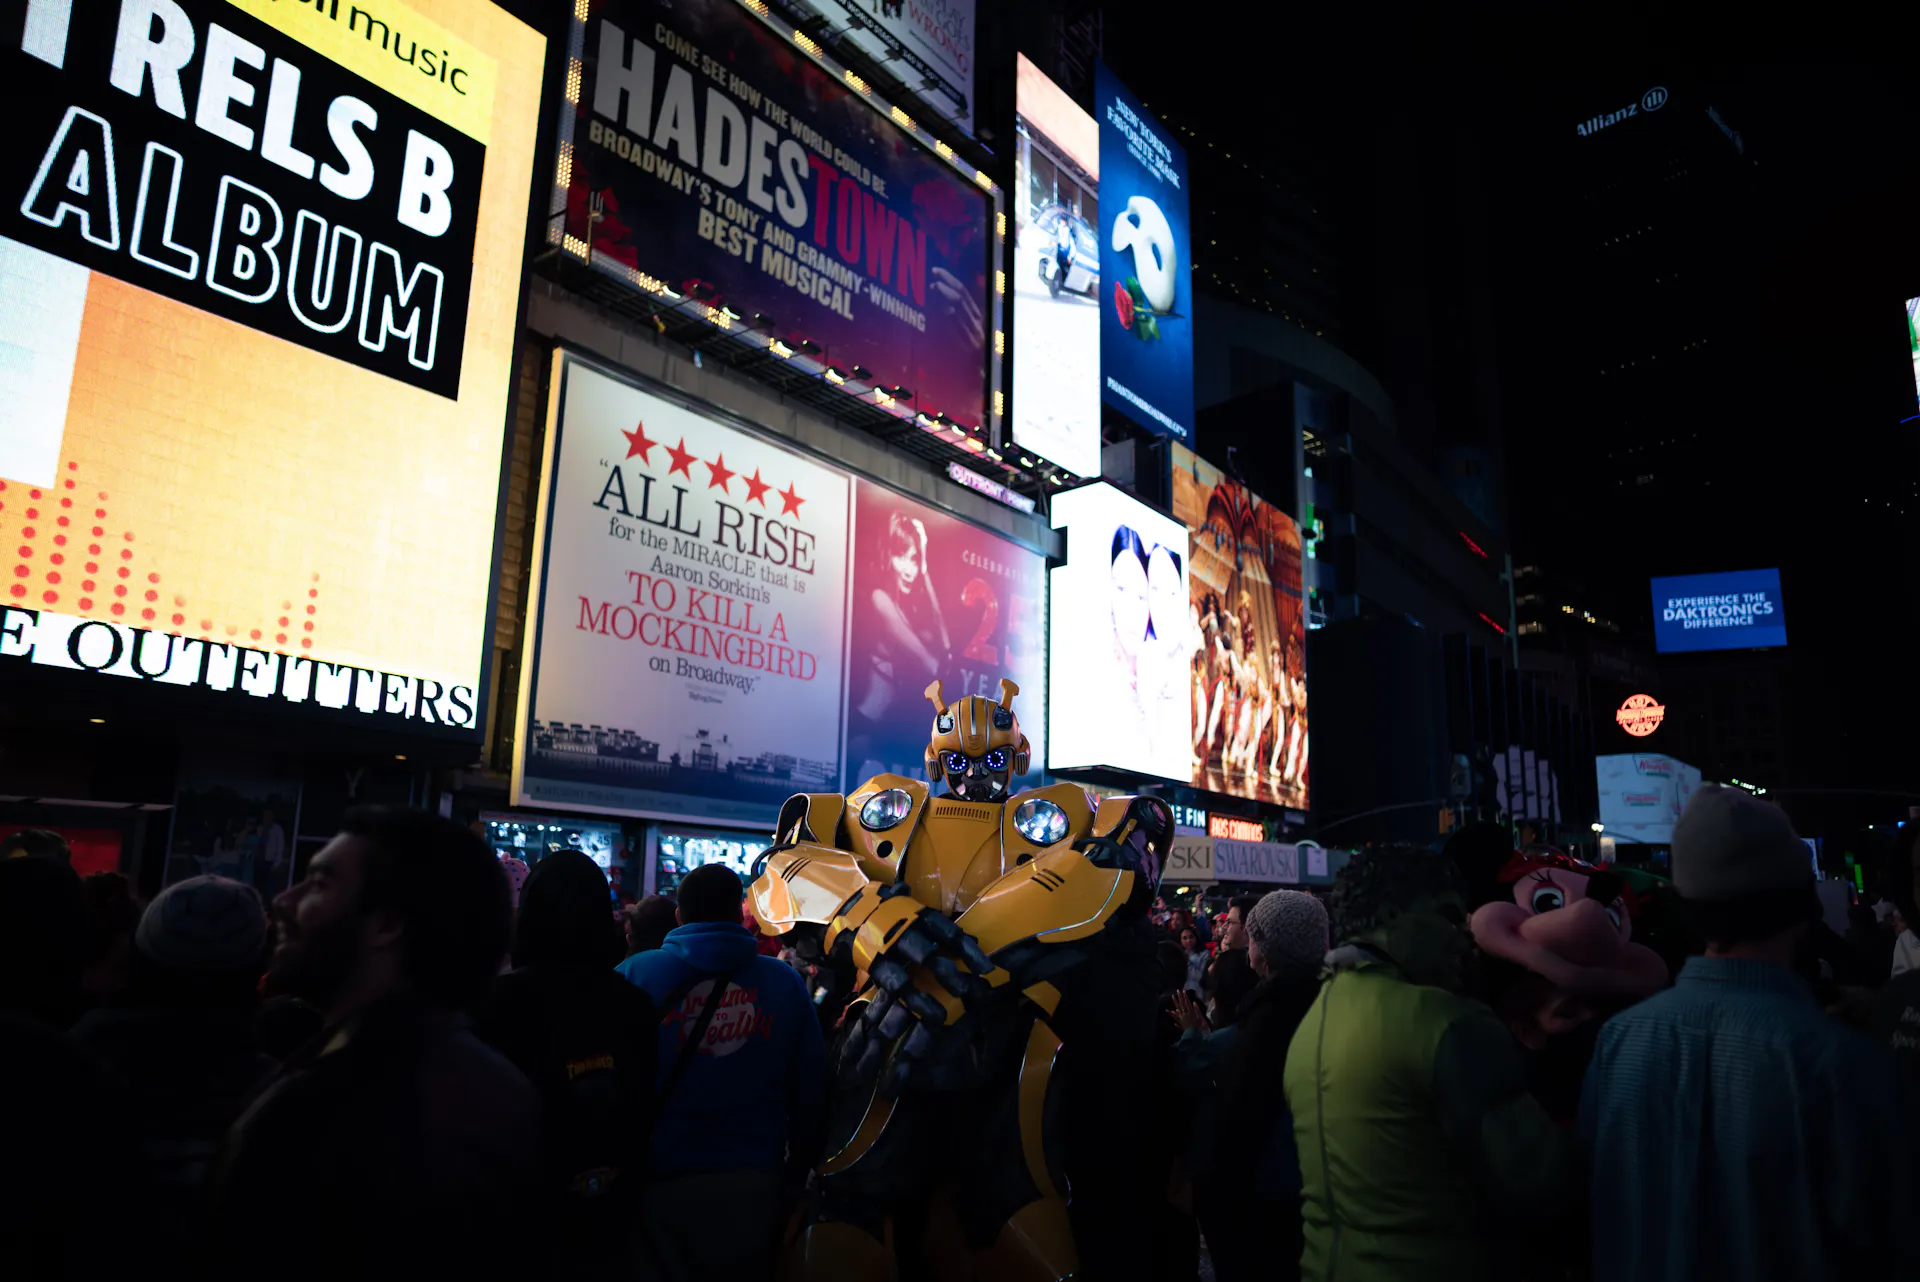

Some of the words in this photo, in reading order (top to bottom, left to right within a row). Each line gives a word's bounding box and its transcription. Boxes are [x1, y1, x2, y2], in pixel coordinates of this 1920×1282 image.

[349, 5, 468, 95] music
[908, 1, 969, 73] WRONG
[654, 22, 700, 67] COME
[701, 54, 728, 86] SEE
[728, 73, 762, 109] HOW
[763, 97, 790, 129] THE
[789, 115, 833, 160] WORLD
[833, 147, 871, 187] COULD
[1576, 103, 1638, 137] Allianz
[588, 119, 712, 206] BROADWAY'S
[762, 221, 796, 255] AND
[20, 105, 445, 371] ALBUM
[697, 207, 758, 264] BEST
[761, 243, 855, 321] MUSICAL
[608, 516, 636, 541] for
[640, 527, 668, 551] the
[672, 537, 756, 578] MIRACLE
[760, 567, 790, 590] that
[793, 574, 807, 594] is
[712, 500, 816, 575] RISE
[650, 554, 703, 586] Aaron
[707, 570, 771, 604] Sorkin's
[685, 586, 763, 635] KILL
[768, 612, 789, 643] A
[1663, 601, 1774, 622] DAKTRONICS
[1668, 593, 1740, 609] EXPERIENCE
[1742, 592, 1766, 603] THE
[1683, 614, 1754, 630] DIFFERENCE
[67, 620, 475, 726] OUTFITTERS
[649, 655, 671, 675] on
[1215, 842, 1297, 879] SWAROVSKI
